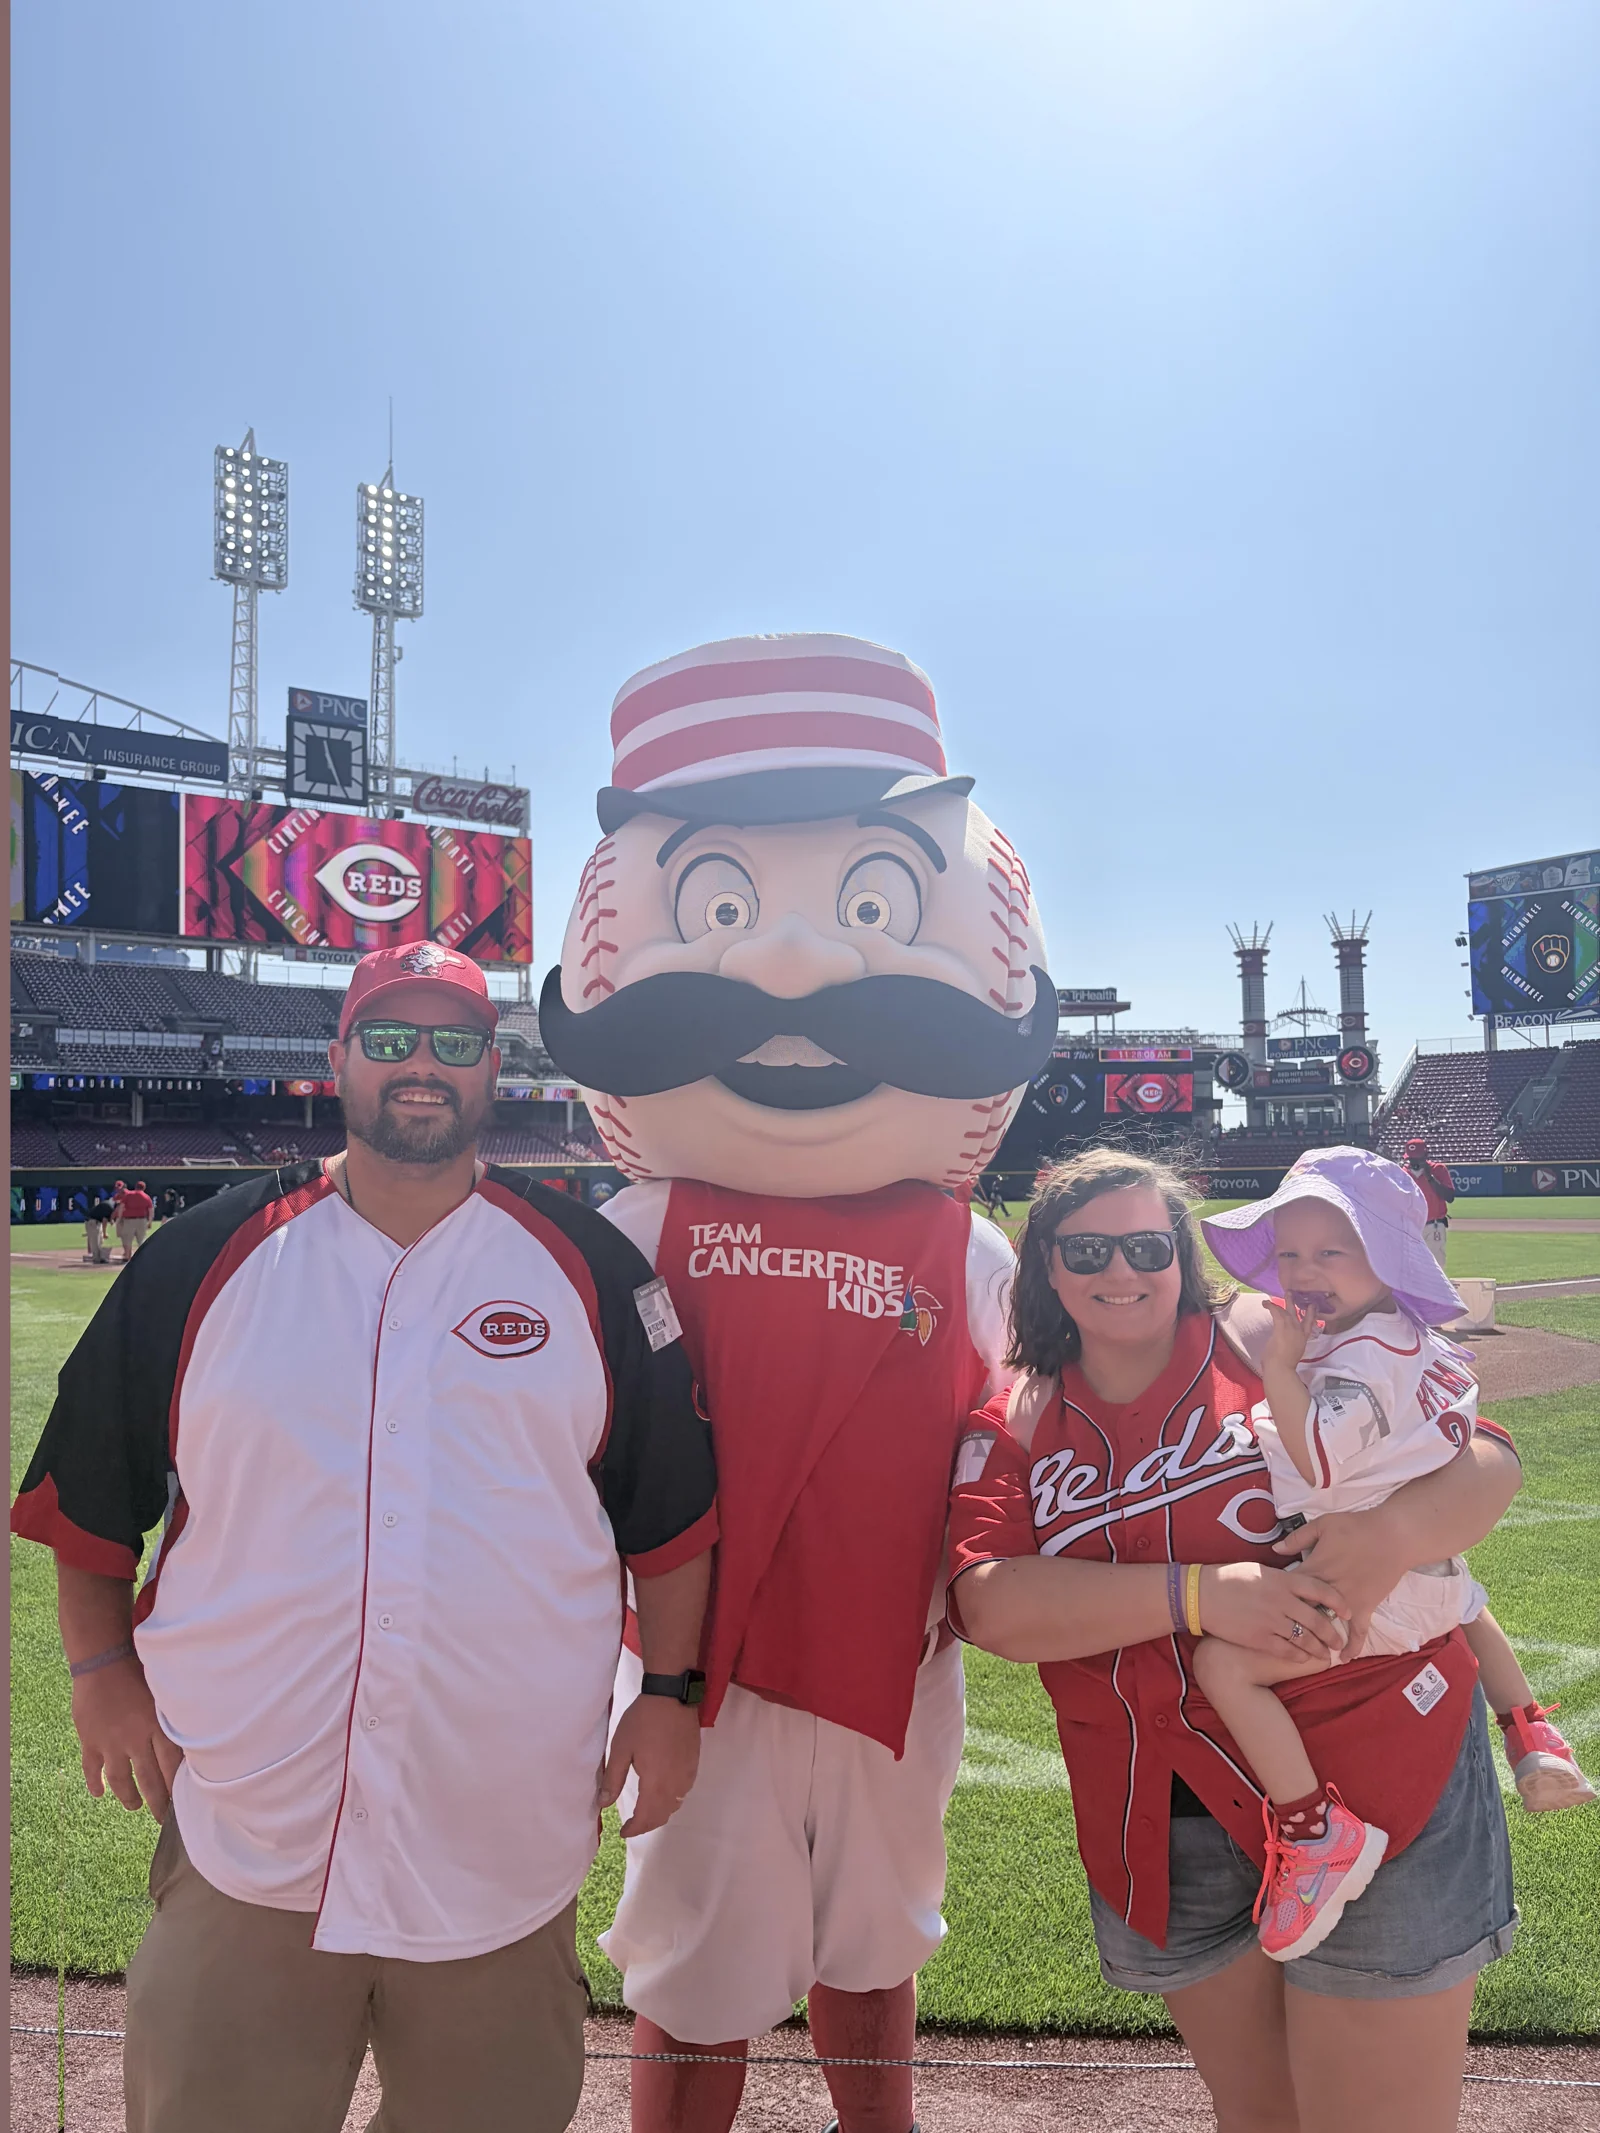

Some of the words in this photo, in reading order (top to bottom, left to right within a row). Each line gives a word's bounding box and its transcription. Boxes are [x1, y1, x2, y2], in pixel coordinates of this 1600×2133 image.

[316, 695, 366, 721] PNC
[103, 749, 176, 770] INSURANCE
[180, 760, 221, 777] GROUP
[413, 776, 529, 826] Coca-Cola
[428, 826, 475, 875] NNATI
[347, 871, 422, 898] REDS
[1501, 903, 1542, 947] MILWAUKEE
[310, 951, 356, 965] TOYOTA
[1071, 990, 1117, 1001] TriHealth
[1500, 965, 1544, 1002] MILWAUKEE
[1494, 1013, 1553, 1029] BEACON
[1269, 1051, 1300, 1059] POWER
[1303, 1049, 1337, 1057] STACKS
[1294, 1037, 1328, 1049] PNC
[1213, 1178, 1260, 1190] TOYOTA
[1450, 1171, 1482, 1192] roger
[689, 1223, 762, 1246] TEAM
[688, 1246, 904, 1293] CANCERFREE
[828, 1280, 904, 1319] KIDS
[484, 1321, 547, 1337] REDS
[1030, 1404, 1262, 1529] Reds
